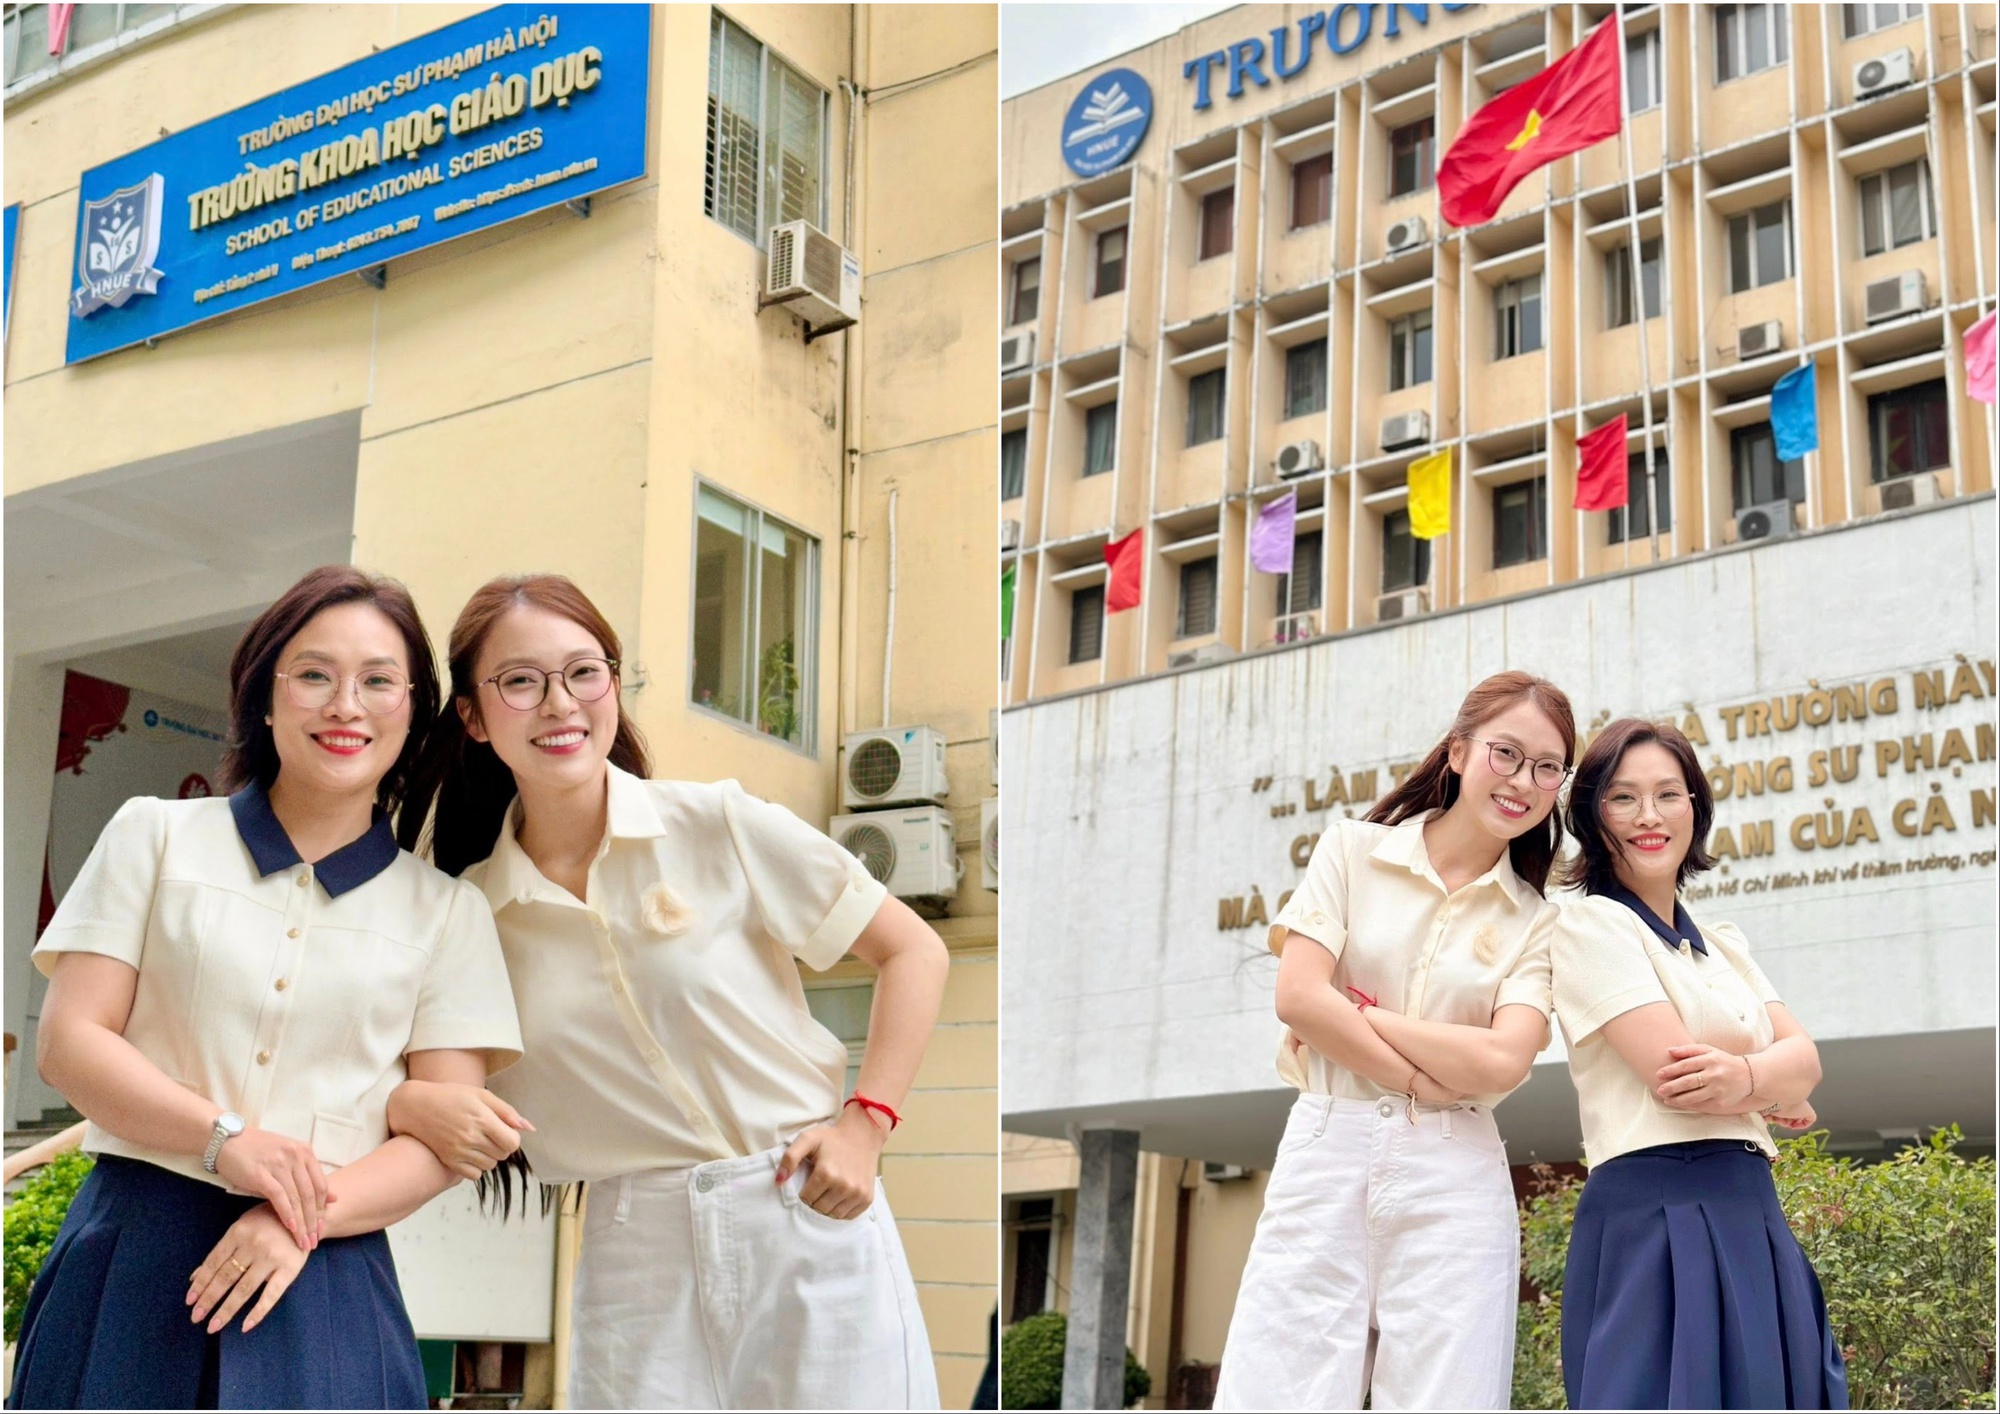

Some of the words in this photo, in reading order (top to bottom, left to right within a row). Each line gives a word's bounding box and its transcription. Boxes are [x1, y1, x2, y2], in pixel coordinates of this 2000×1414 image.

[237, 110, 315, 156] TRƯỜNG
[316, 96, 349, 127] ĐẠI
[350, 80, 391, 115] HỌC
[393, 64, 422, 97] SƯ
[422, 43, 484, 85] PHẠM
[485, 27, 517, 62] HÀ
[518, 13, 558, 48] NỘI
[188, 157, 299, 232] TRƯỜNG
[298, 127, 381, 192] KHOA
[380, 102, 448, 161] HỌC
[449, 71, 528, 136] GIÁO
[530, 45, 603, 108] DỤC
[225, 215, 293, 257] SCHOOL
[295, 204, 321, 232] OF
[322, 163, 445, 223] EDUCATIONAL
[448, 126, 544, 179] SCIENCES
[91, 272, 133, 299] HNUE
[1718, 677, 1899, 742] TRƯỜNG
[1305, 764, 1377, 813] LÀM
[1807, 744, 1863, 788] SƯ
[1789, 797, 1880, 852] CỦA
[1891, 782, 1957, 838] CẢ
[1217, 884, 1269, 932] MÀ
